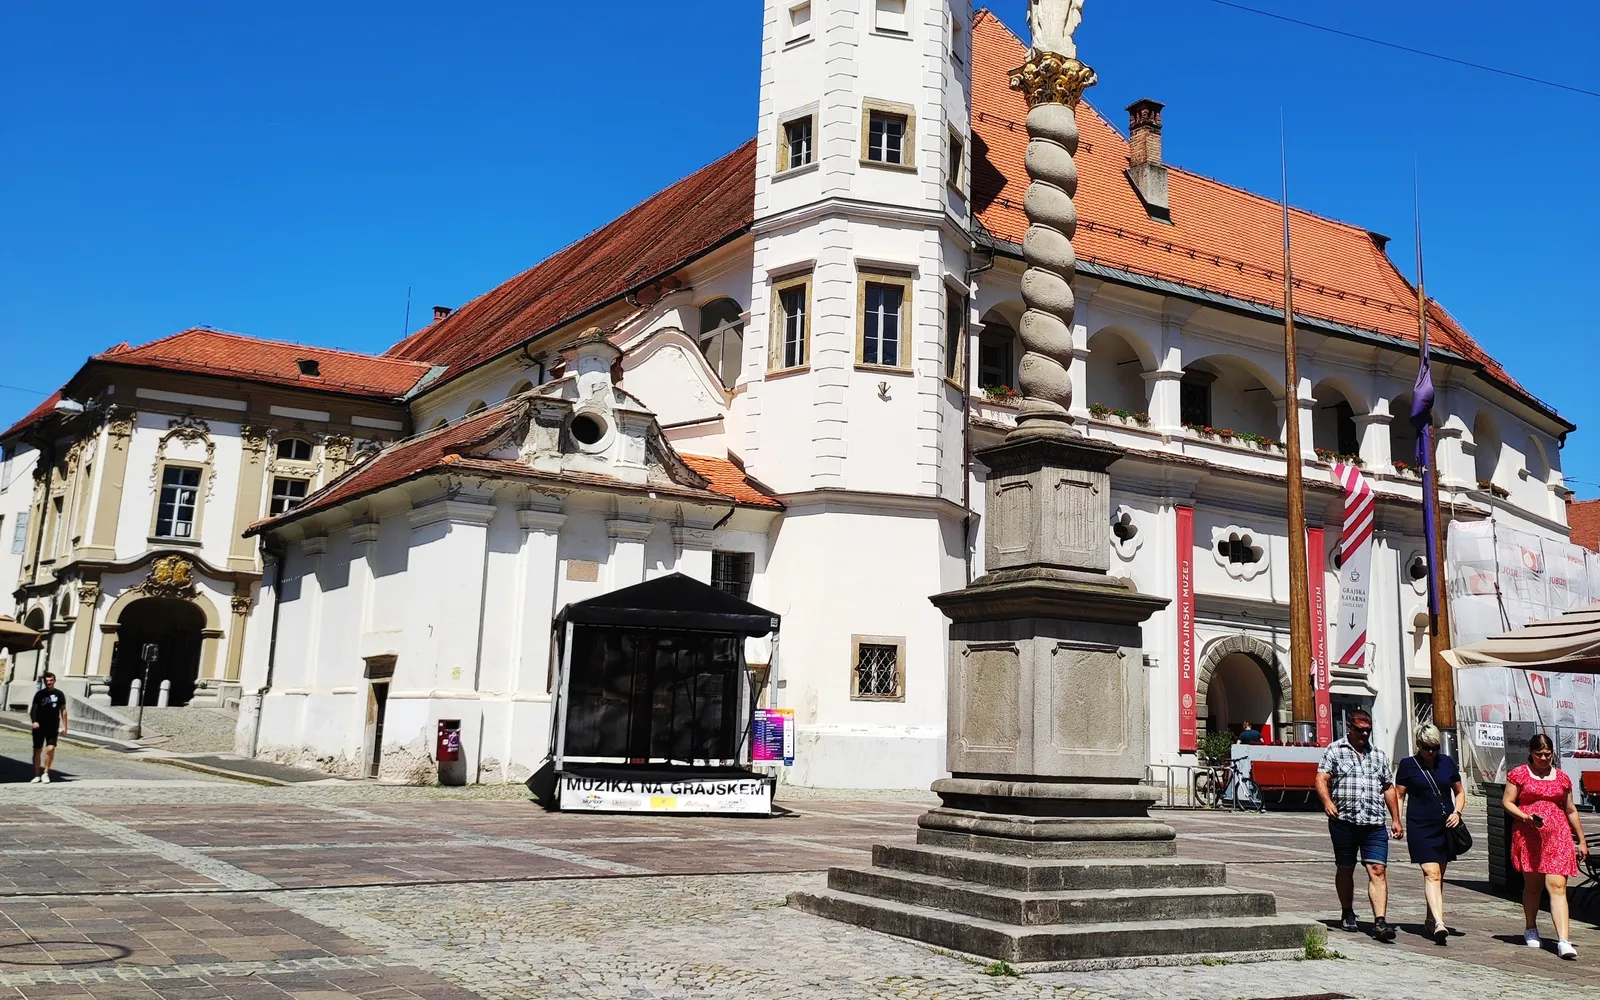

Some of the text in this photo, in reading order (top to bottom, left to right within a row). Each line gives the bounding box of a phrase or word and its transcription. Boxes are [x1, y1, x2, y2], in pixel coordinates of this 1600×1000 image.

[1342, 587, 1366, 595] GRAJSKA
[1182, 602, 1190, 679] POKRAJINSKI
[566, 778, 764, 795] MUZIKA NA GRAJSKEM
